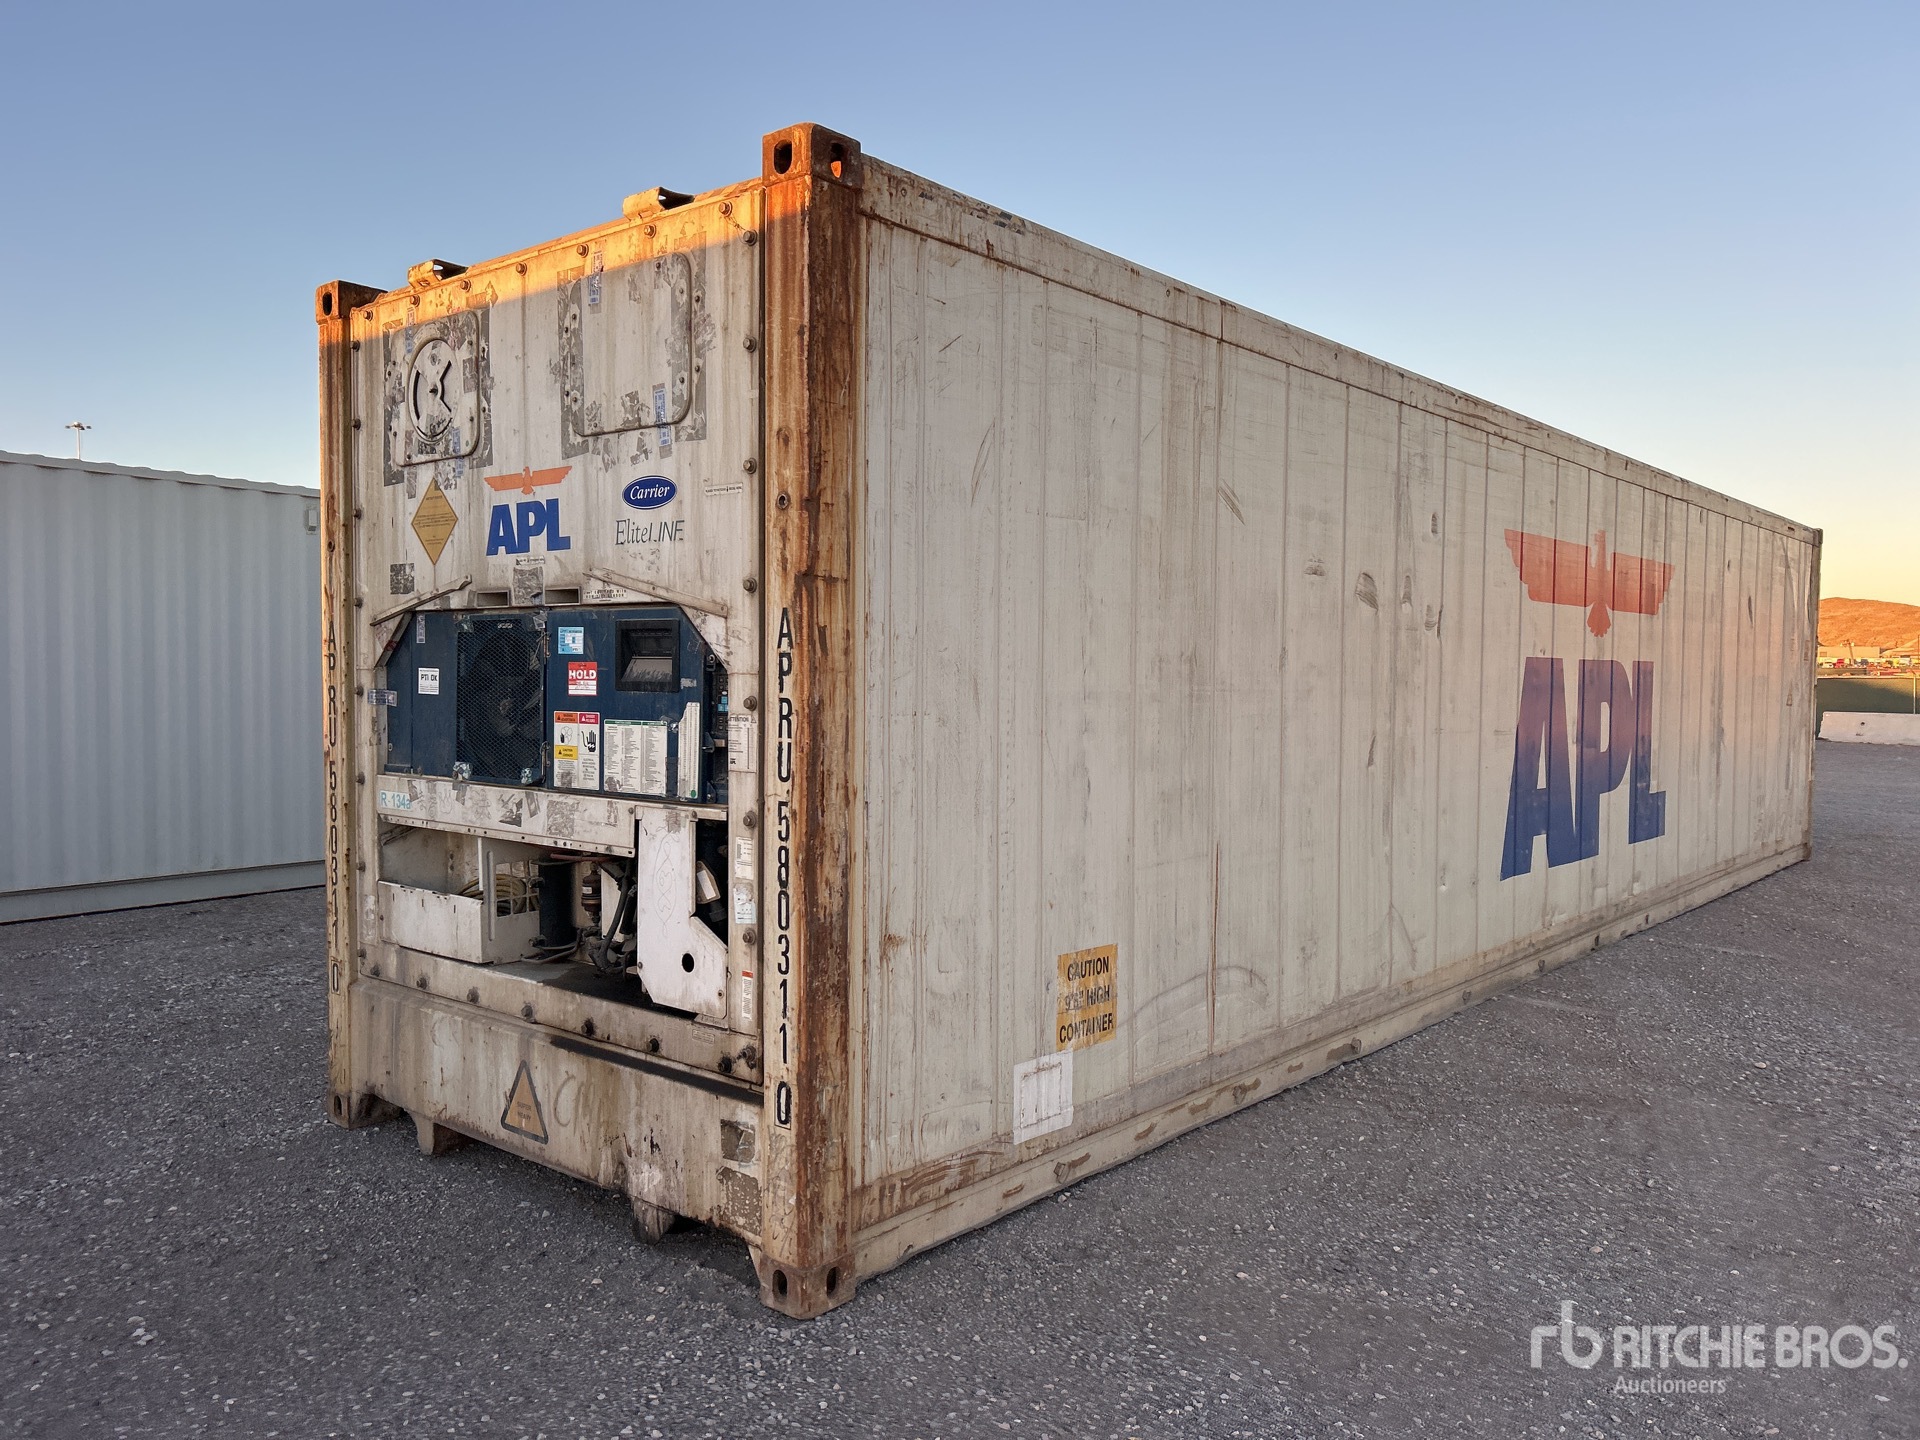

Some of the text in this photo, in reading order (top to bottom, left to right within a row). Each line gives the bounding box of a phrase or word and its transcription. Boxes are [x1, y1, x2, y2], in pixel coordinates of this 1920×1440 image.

[630, 484, 670, 500] Carrier
[486, 498, 571, 556] APL
[569, 670, 596, 680] HOLD
[1500, 657, 1666, 881] APL
[380, 791, 411, 810] R-134a
[777, 607, 793, 1124] APRU 580311 0
[1067, 956, 1109, 981] CAUTION
[1086, 985, 1110, 1006] HIGH
[1059, 1013, 1114, 1043] CONTAINER
